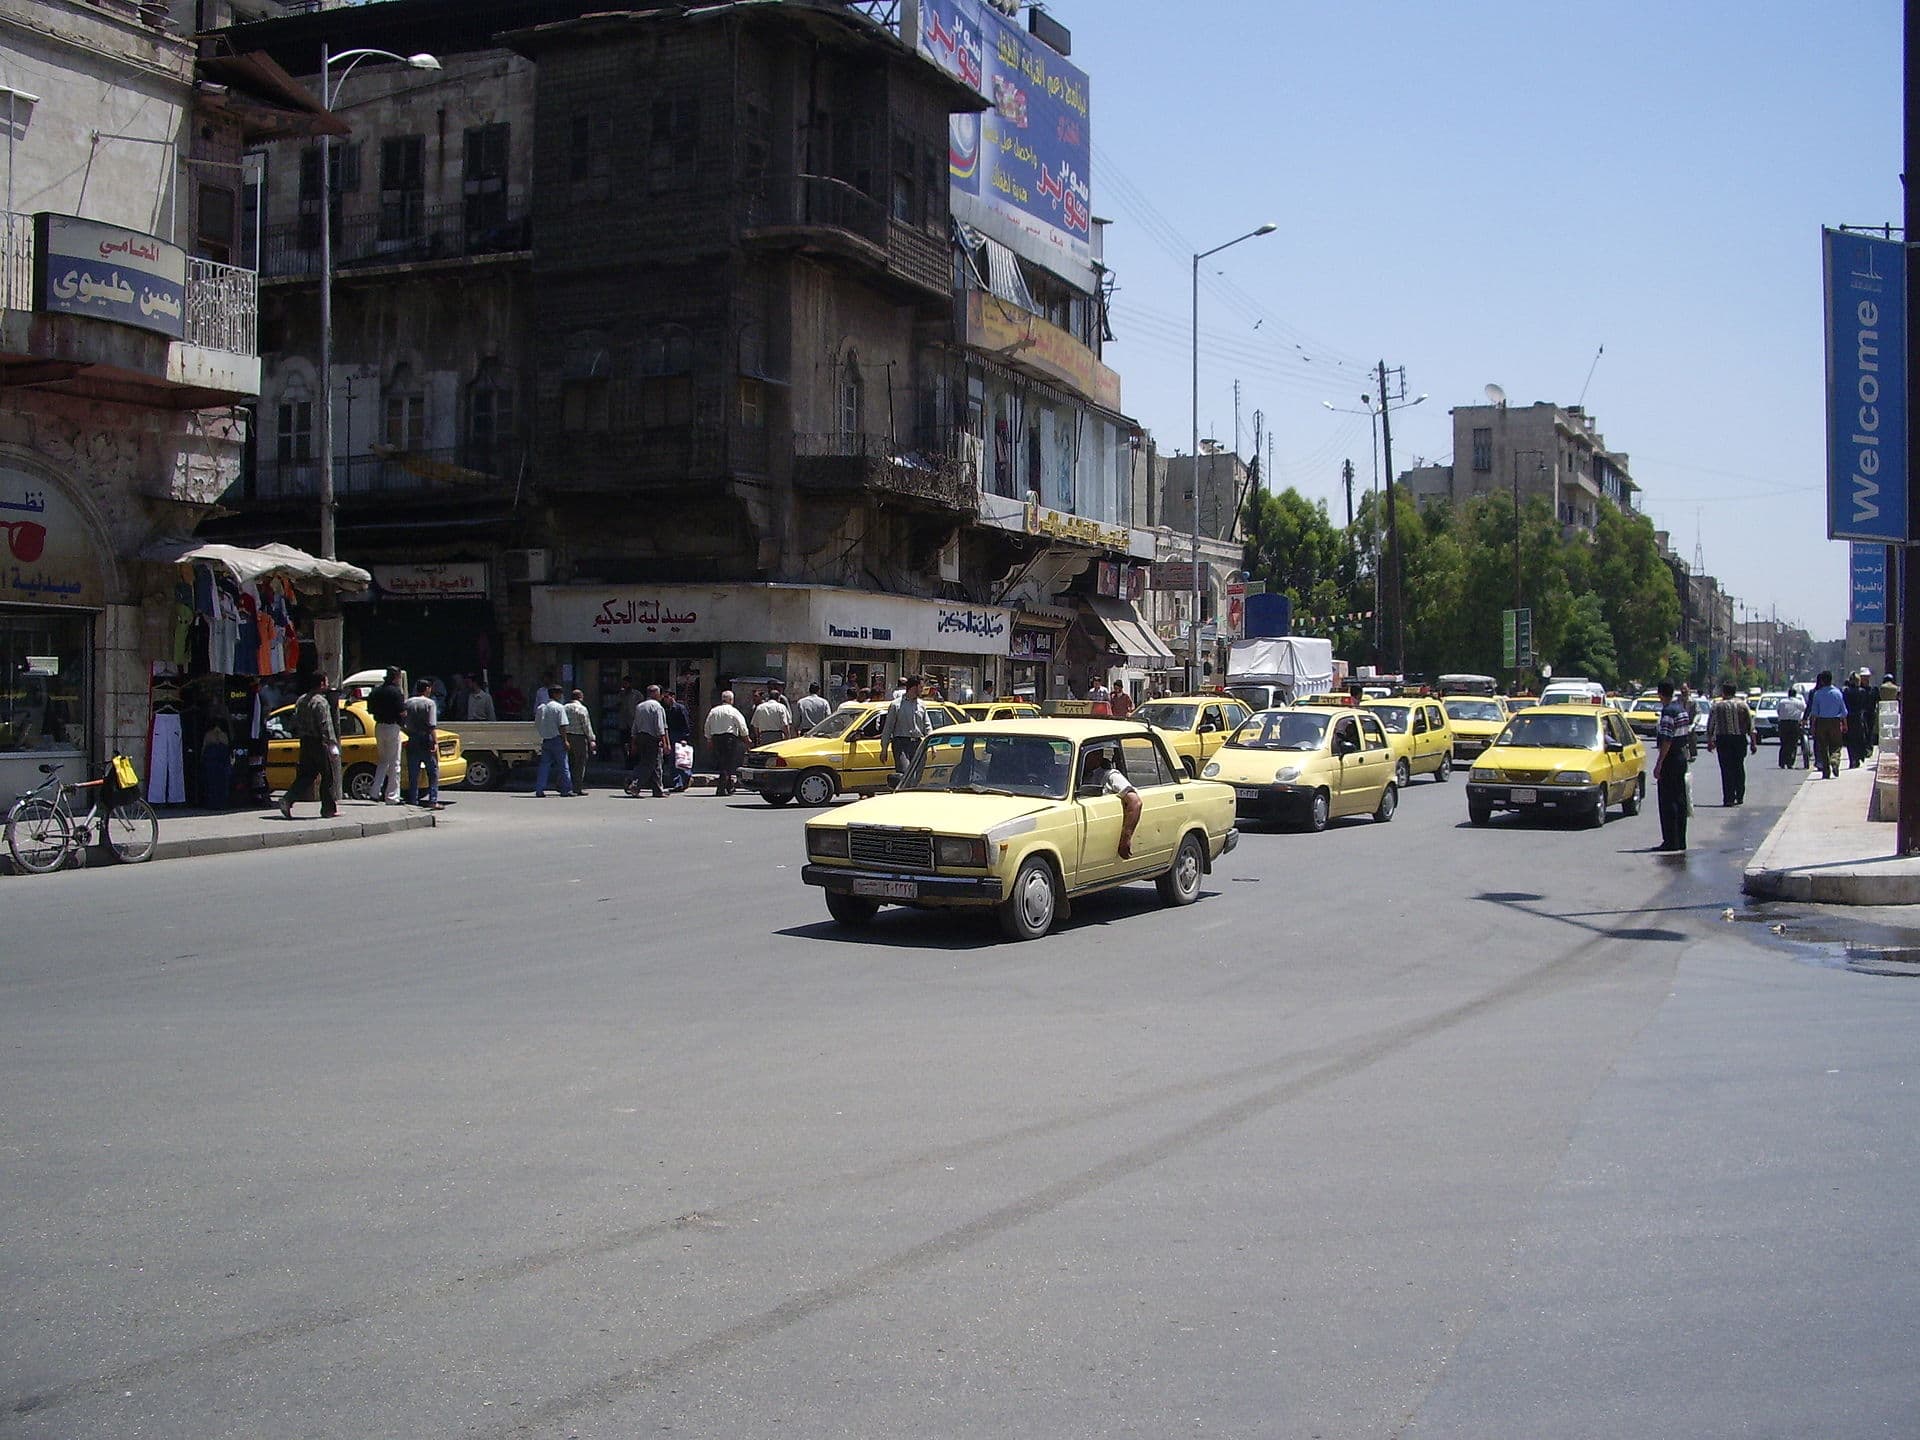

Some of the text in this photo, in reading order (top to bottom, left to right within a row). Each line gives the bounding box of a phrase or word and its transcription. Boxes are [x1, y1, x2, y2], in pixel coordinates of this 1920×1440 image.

[99, 237, 159, 263] المحامي
[53, 265, 182, 320] معين حليوي
[1853, 300, 1879, 523] Welcome
[593, 598, 697, 634] صيدلية الحكيم
